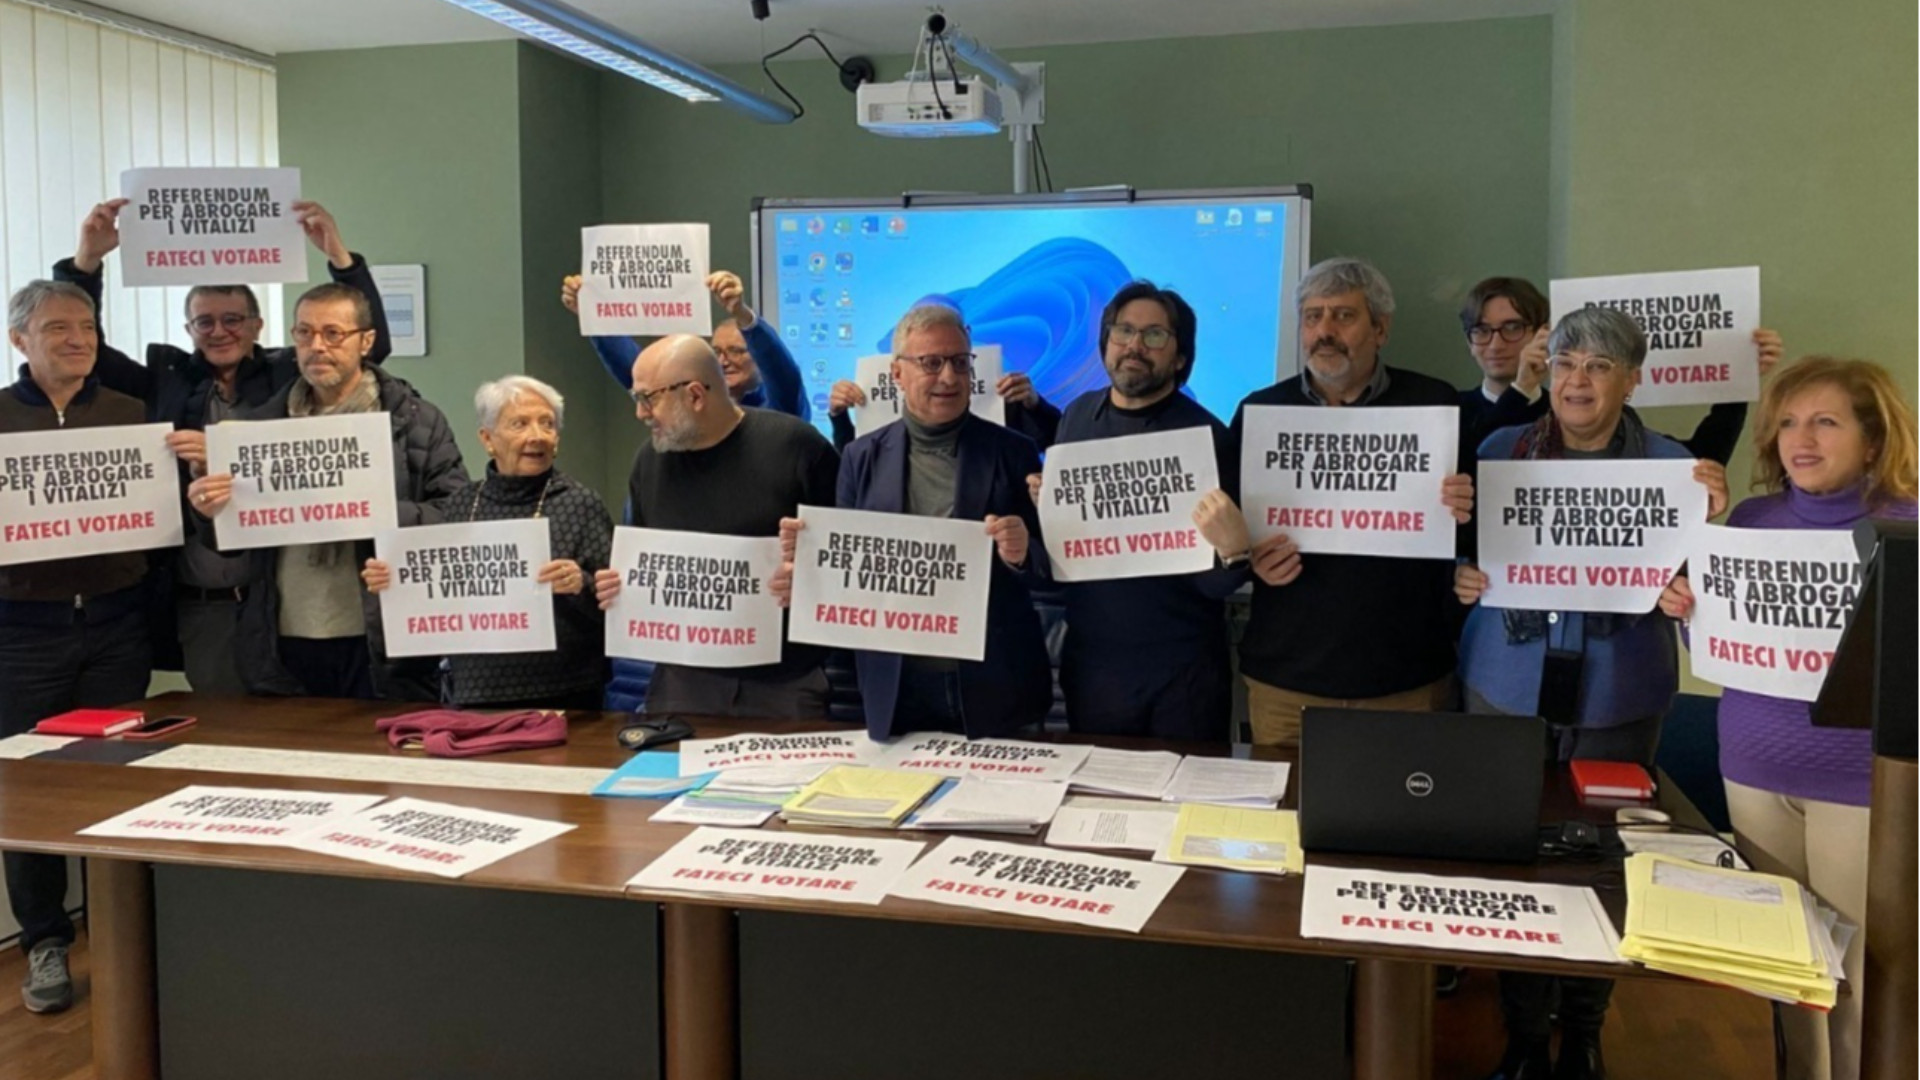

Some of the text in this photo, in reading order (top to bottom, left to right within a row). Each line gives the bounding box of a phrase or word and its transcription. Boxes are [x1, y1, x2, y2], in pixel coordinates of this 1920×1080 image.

[148, 187, 270, 203] REFERENDUM
[139, 202, 281, 220] PER ABROGARE
[168, 218, 256, 235] I VITALIZI
[146, 248, 282, 267] FATECI VOTARE
[596, 245, 683, 260] REFERENDUM
[590, 259, 691, 275] PER ABROGARE
[609, 274, 672, 289] I VITALIZI
[596, 302, 693, 318] FATECI VOTARE
[1636, 311, 1733, 333] BROGARE
[1645, 330, 1702, 350] ALIZI
[1650, 364, 1730, 385] VOTARE
[871, 387, 898, 401] PER
[893, 400, 898, 414] I
[238, 437, 358, 462] REFERENDUM
[1277, 432, 1419, 454] REFERENDUM
[5, 448, 142, 474] REFERENDUM
[230, 452, 371, 478] PER ABROGARE
[1060, 455, 1182, 487] REFERENDUM
[1265, 451, 1430, 472] PER ABROGARE
[0, 463, 154, 492] PER ABROGARE
[257, 471, 344, 493] I VITALIZI
[1296, 471, 1397, 491] I VITALIZI
[29, 482, 126, 505] I VITALIZI
[1054, 473, 1195, 505] PER ABROGARE
[1514, 487, 1665, 507] REFERENDUM
[238, 501, 371, 527] FATECI VOTARE
[1081, 495, 1170, 520] I VITALIZI
[1502, 507, 1679, 528] PER ABROGARE
[4, 511, 155, 542] FATECI VOTARE
[1267, 507, 1424, 531] FATECI VOTARE
[828, 532, 956, 562] REFERENDUM
[1064, 529, 1196, 558] FATECI VOTARE
[1535, 527, 1644, 547] I VITALIZI
[405, 543, 518, 567] REFERENDUM
[638, 552, 750, 577] REFERENDUM
[817, 550, 966, 580] PER ABROGARE
[399, 560, 528, 583] PER ABROGARE
[627, 570, 761, 594] PER ABROGARE
[1507, 565, 1672, 587] FATECI VOTARE
[427, 579, 506, 599] I VITALIZI
[844, 571, 936, 597] I VITALIZI
[1703, 573, 1857, 607] PER ABROGA
[650, 588, 733, 611] I VITALIZI
[1730, 600, 1737, 621] I
[407, 612, 529, 634] FATECI VOTARE
[816, 603, 959, 634] FATECI VOTARE
[628, 620, 757, 645] FATECI VOTARE
[1709, 636, 1836, 673] FATECI VOT
[698, 845, 743, 856] PER
[720, 838, 875, 857] REFERENDUM
[723, 855, 840, 871] I VITALIZI
[950, 856, 996, 869] PER
[971, 850, 1132, 879] REFERENDUM
[672, 868, 857, 890] FATECI VOTARE
[974, 868, 1095, 893] I VITALIZI
[925, 879, 1115, 915] FATECI VOTARE
[1336, 888, 1388, 900] PER
[1351, 880, 1539, 904] REFERENDUM
[1378, 900, 1517, 921] I VITALIZI
[1341, 915, 1563, 944] FATECI VOTARE
